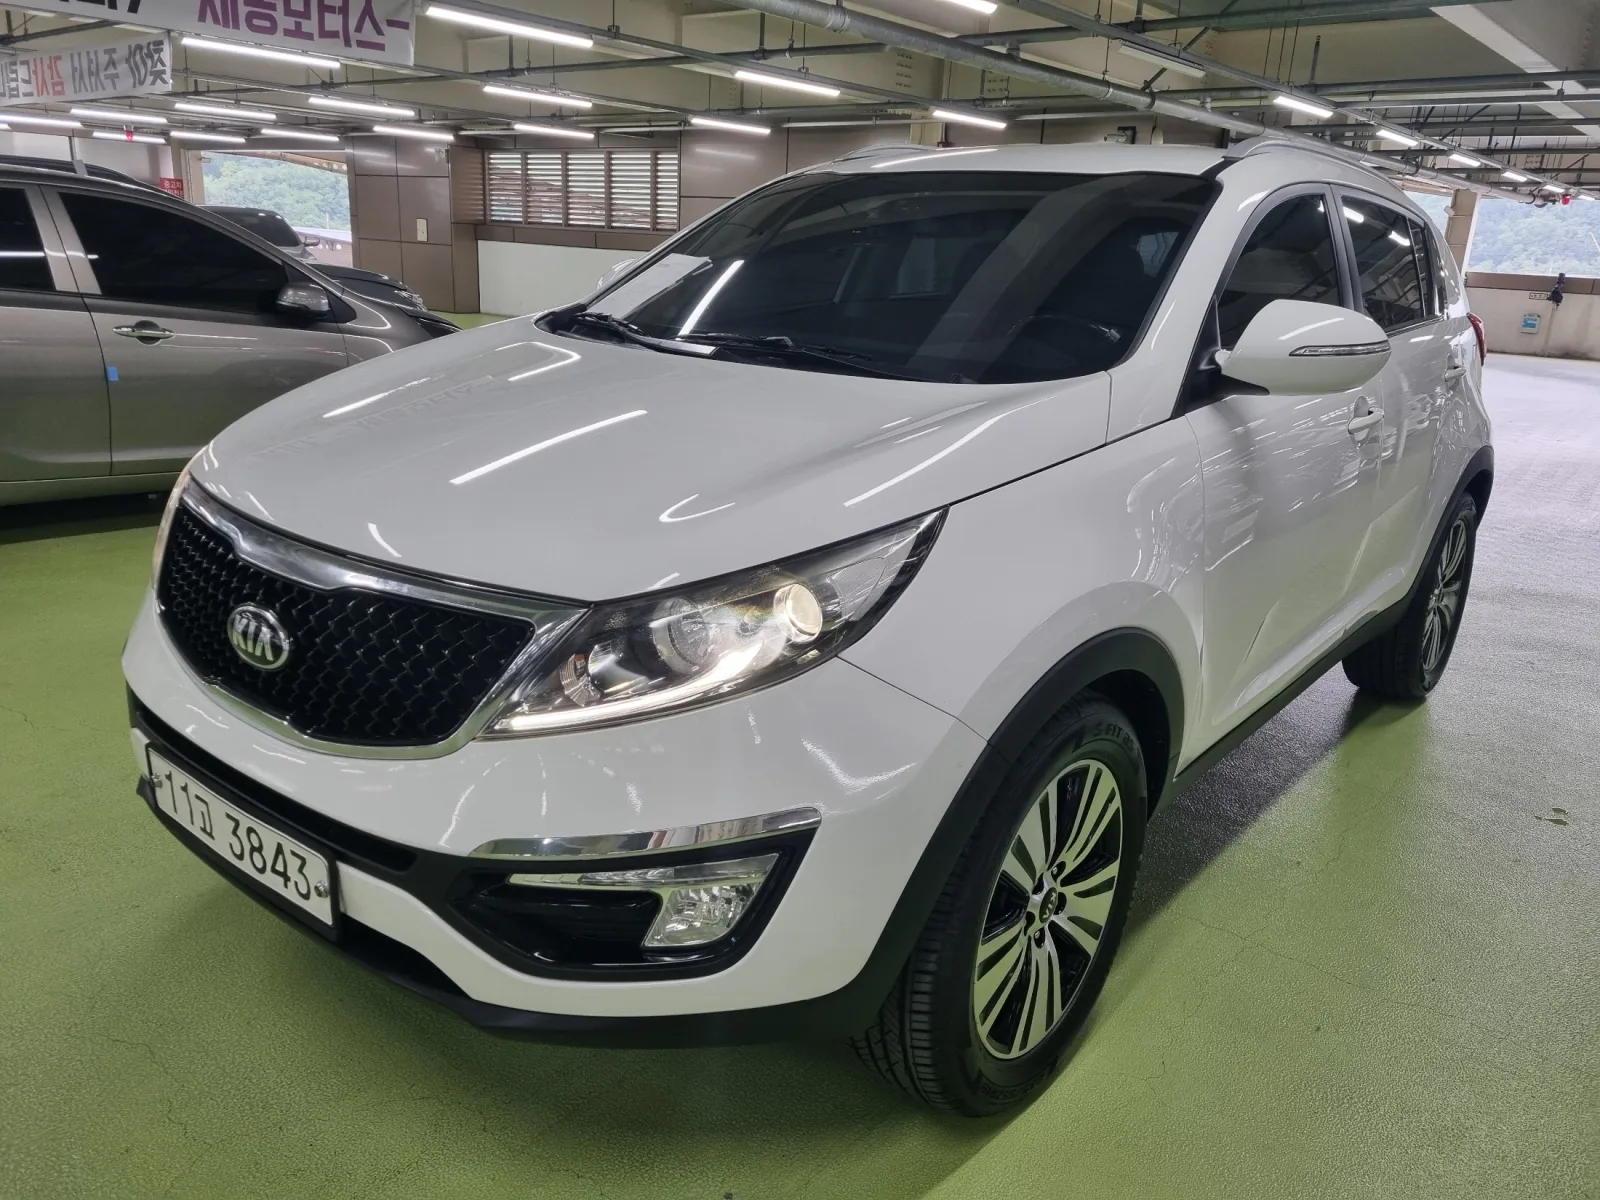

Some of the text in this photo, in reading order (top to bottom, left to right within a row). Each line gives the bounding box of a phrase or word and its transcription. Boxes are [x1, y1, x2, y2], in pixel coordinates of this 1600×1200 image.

[232, 614, 274, 662] KIA
[165, 771, 312, 901] 11고 3843
